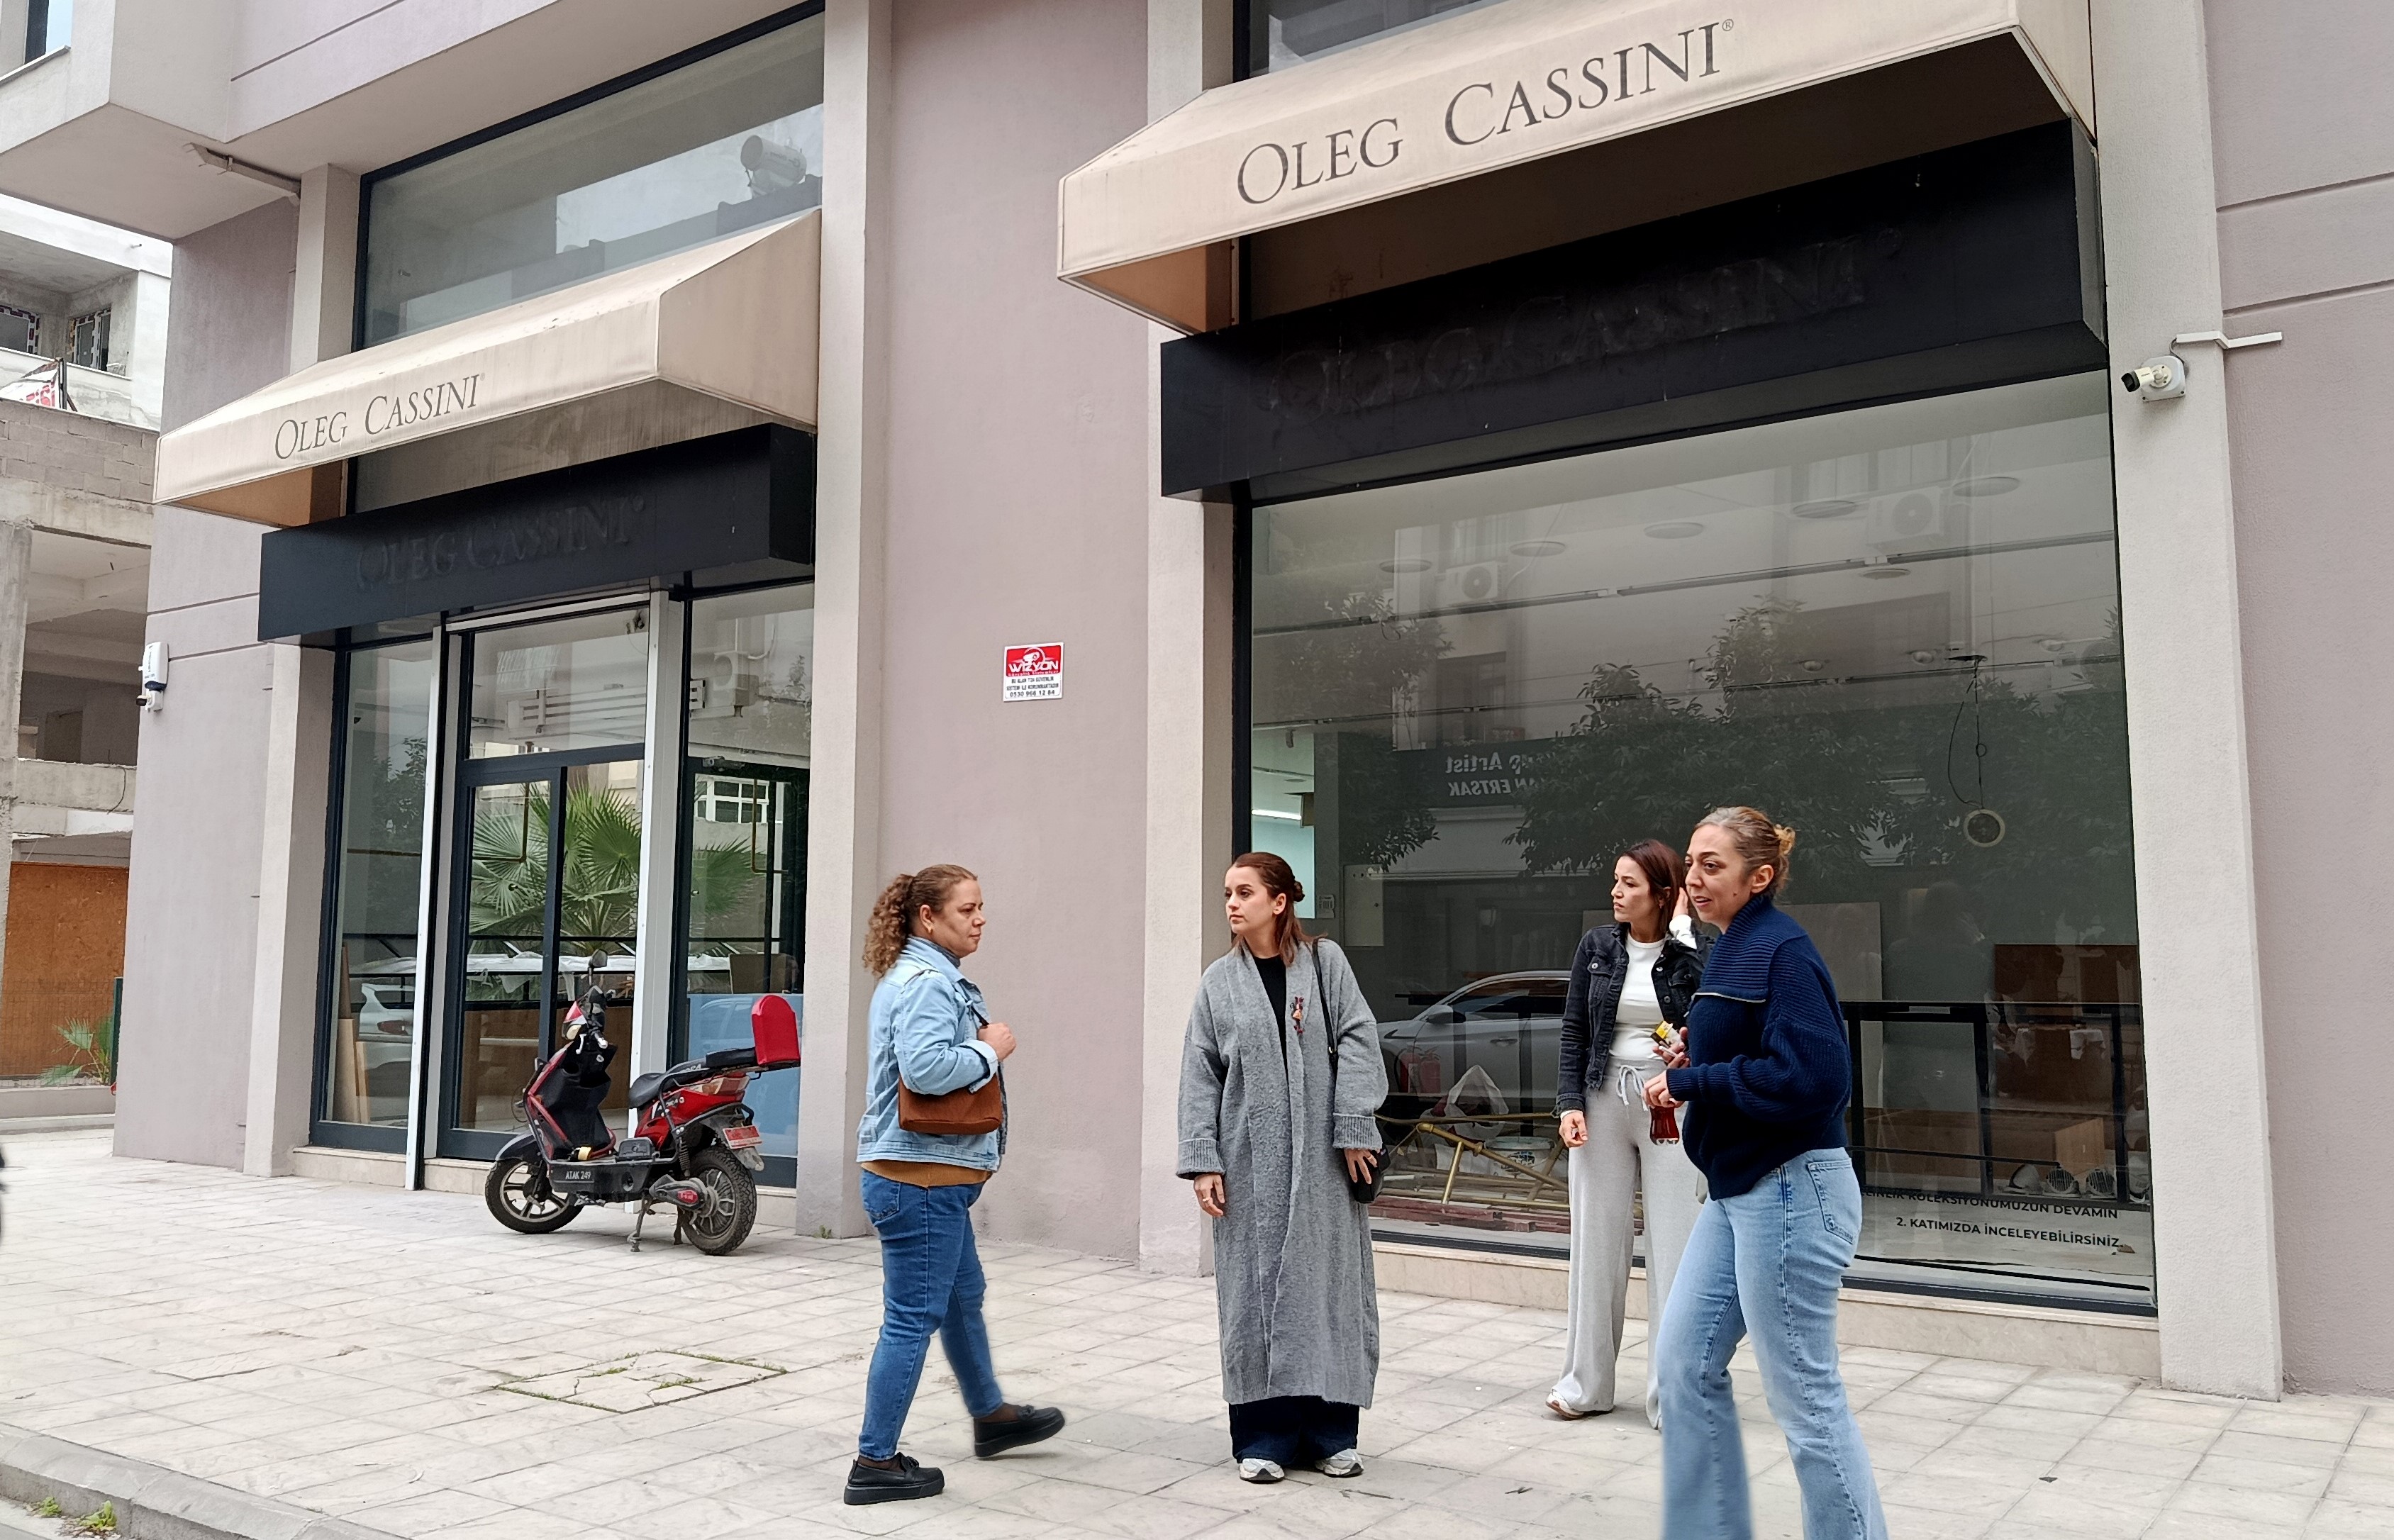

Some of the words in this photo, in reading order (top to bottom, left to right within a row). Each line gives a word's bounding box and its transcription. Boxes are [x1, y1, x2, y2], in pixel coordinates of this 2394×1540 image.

[1237, 118, 1403, 204] OLEG
[274, 411, 349, 460] OLEG
[565, 1171, 580, 1180] ATAK
[580, 1171, 591, 1180] 249
[1895, 1217, 1907, 1227] 2.
[1910, 1218, 1981, 1234] KATIMIZDA
